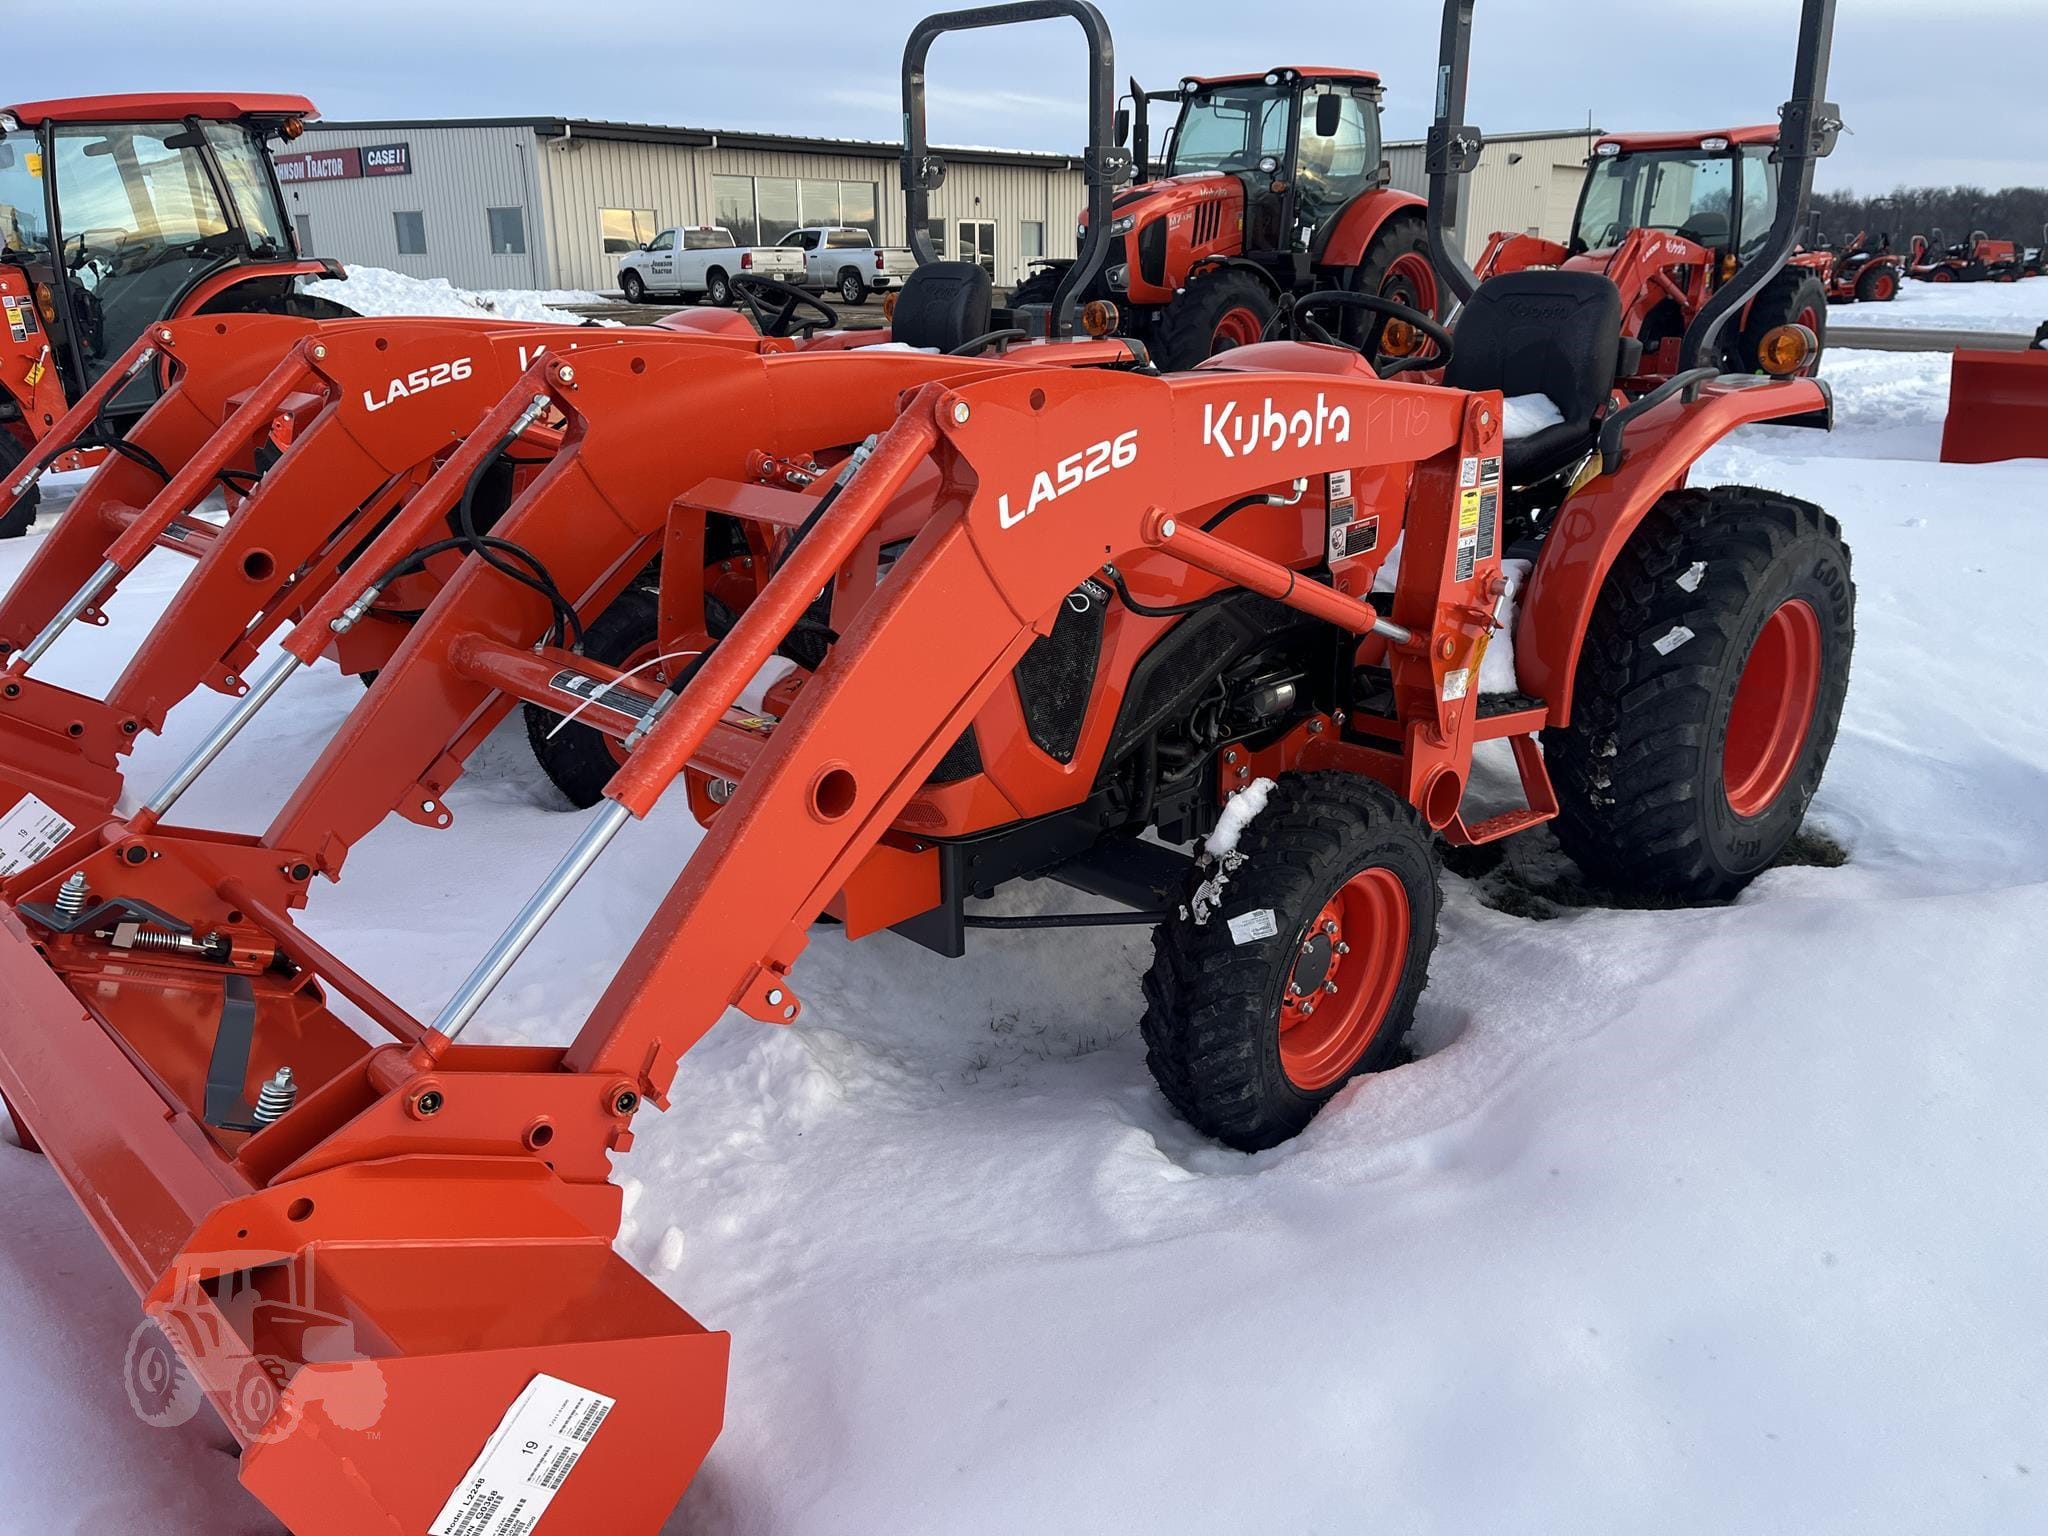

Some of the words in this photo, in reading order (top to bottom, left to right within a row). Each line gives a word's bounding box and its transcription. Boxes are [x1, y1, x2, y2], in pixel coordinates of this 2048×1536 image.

[305, 155, 344, 178] TRACTOR
[362, 357, 473, 412] LA526
[1202, 392, 1351, 458] Kubota
[998, 429, 1139, 530] LA526
[18, 828, 28, 838] 19
[522, 1440, 539, 1455] 19
[444, 1509, 465, 1536] Model
[463, 1478, 485, 1506] L2248
[475, 1490, 498, 1519] G0368
